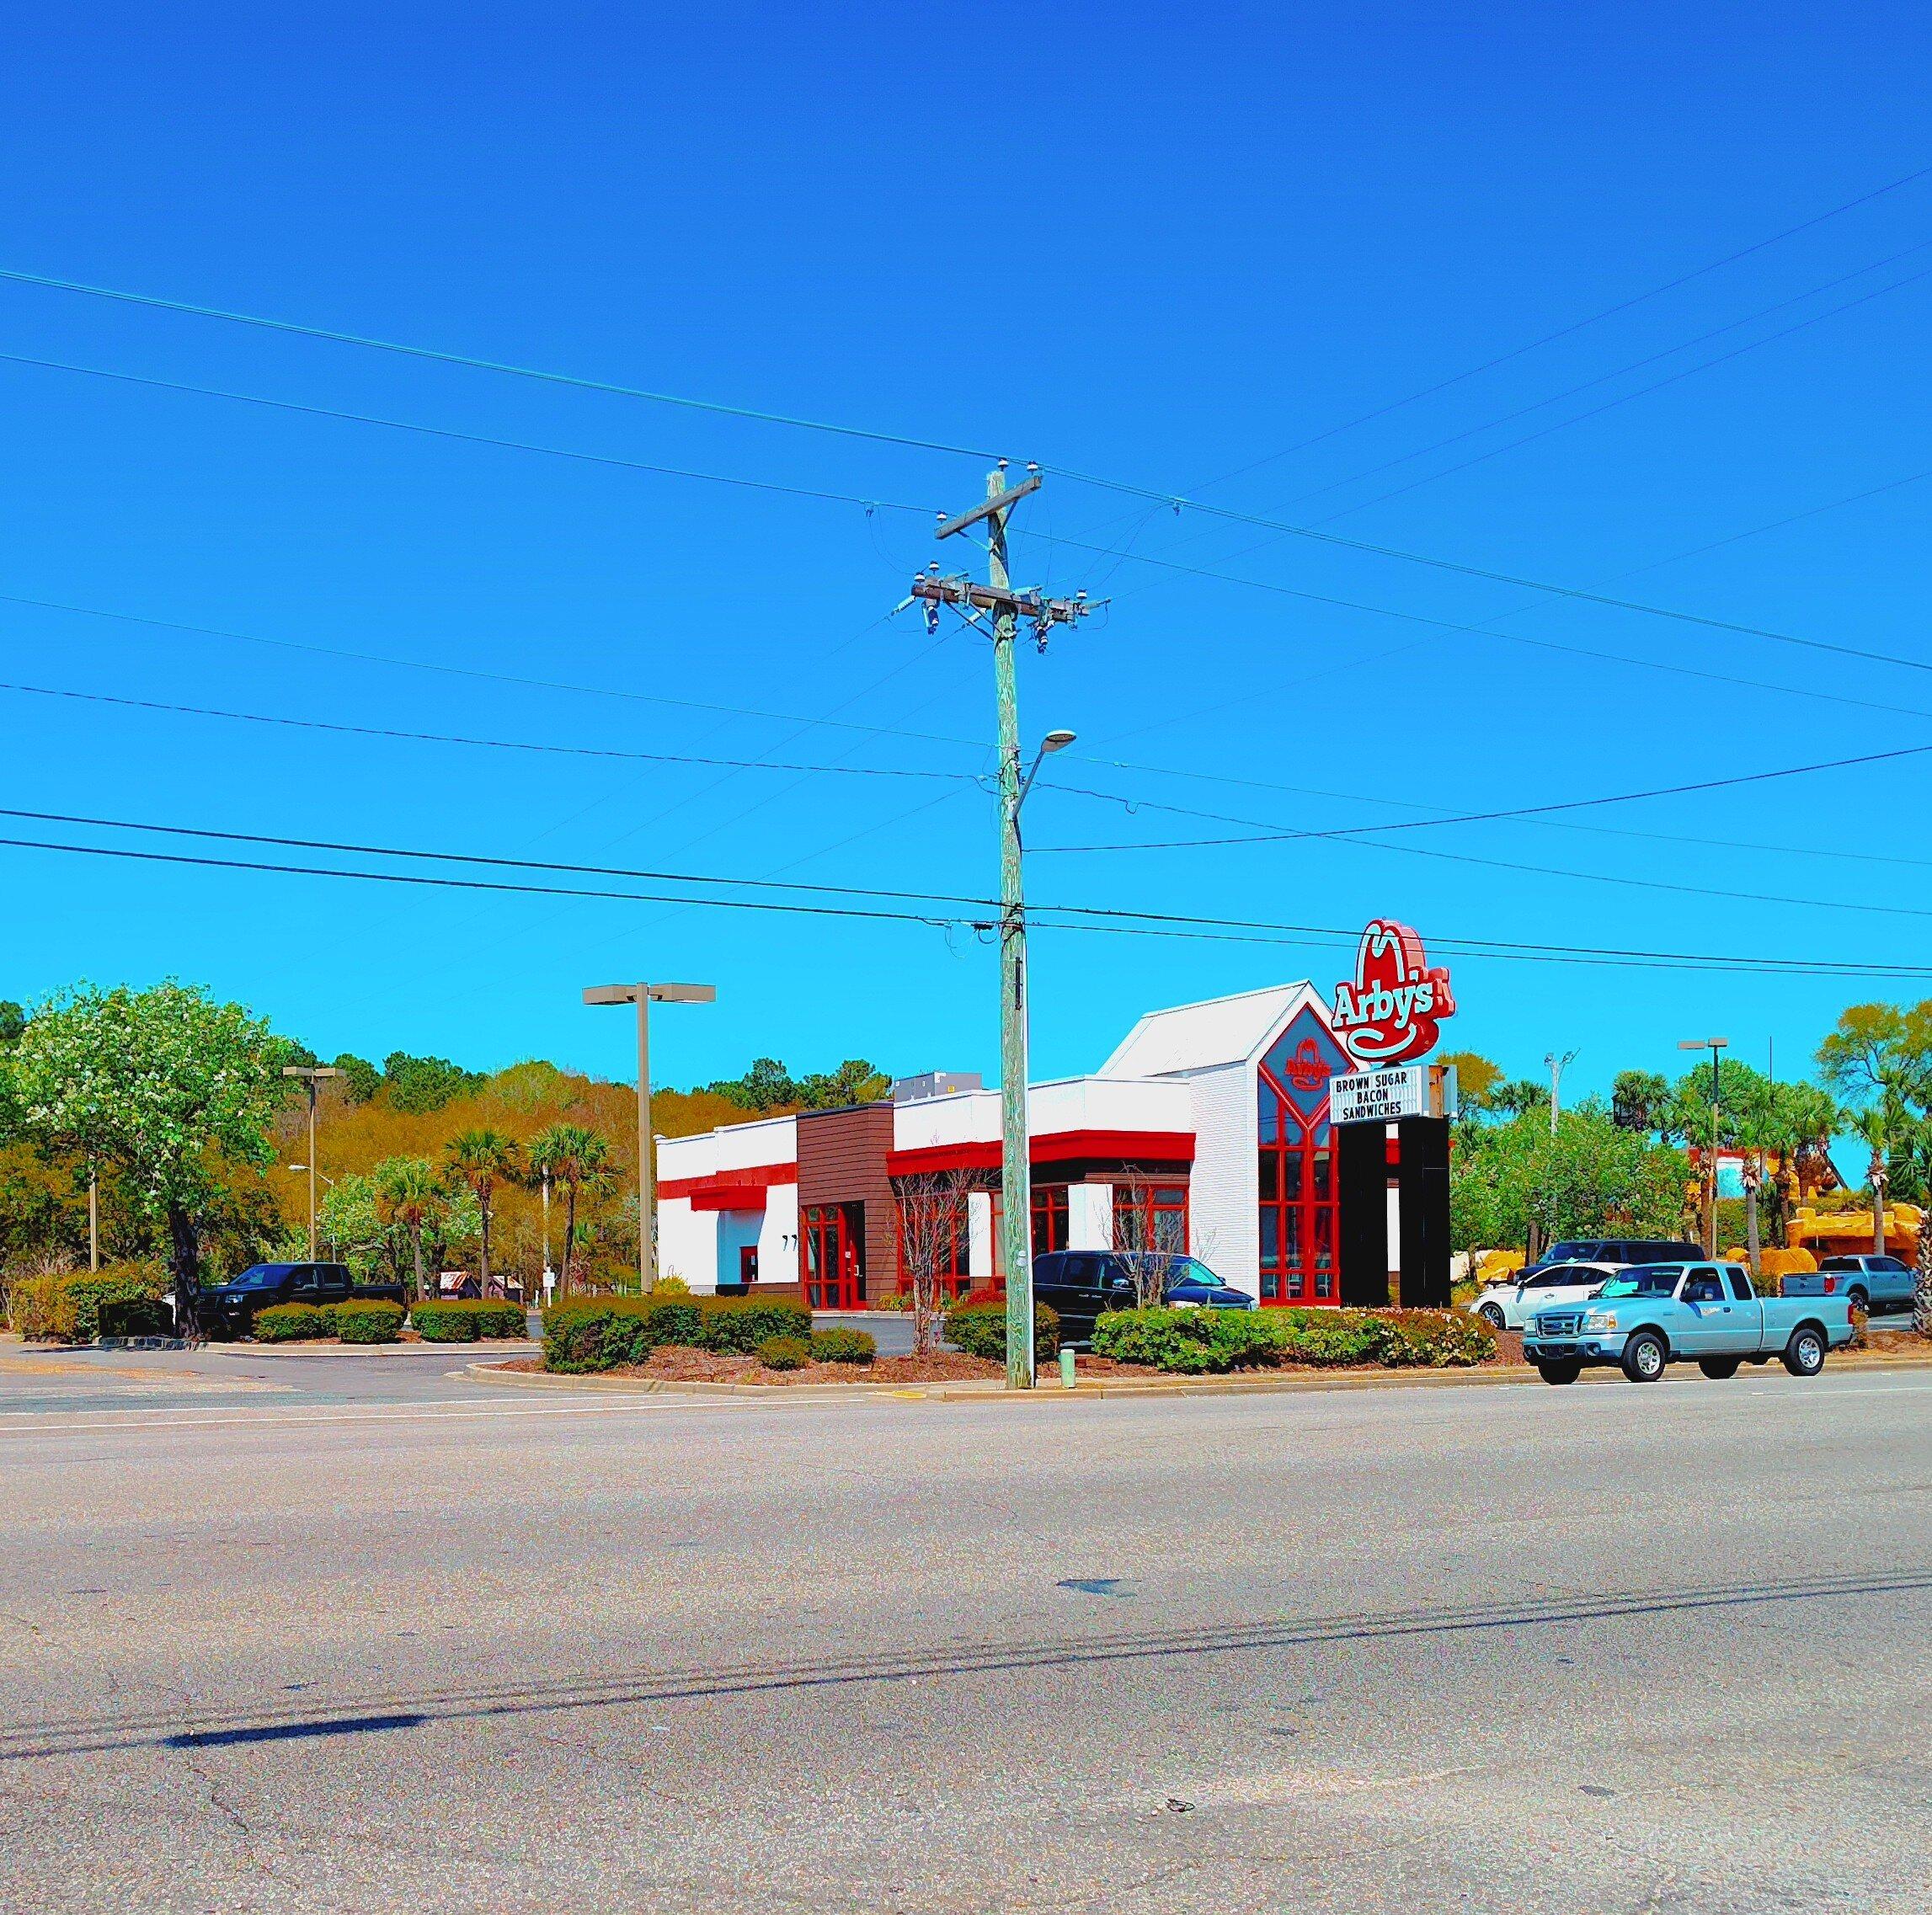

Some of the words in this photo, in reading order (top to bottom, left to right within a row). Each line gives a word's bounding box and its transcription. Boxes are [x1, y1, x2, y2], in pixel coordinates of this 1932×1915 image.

[1332, 970, 1433, 1029] Arby's
[1336, 1076, 1369, 1093] BROWN
[1375, 1071, 1407, 1087] SUGAR
[1357, 1088, 1389, 1105] BACON
[1342, 1101, 1401, 1121] SANDWICHES
